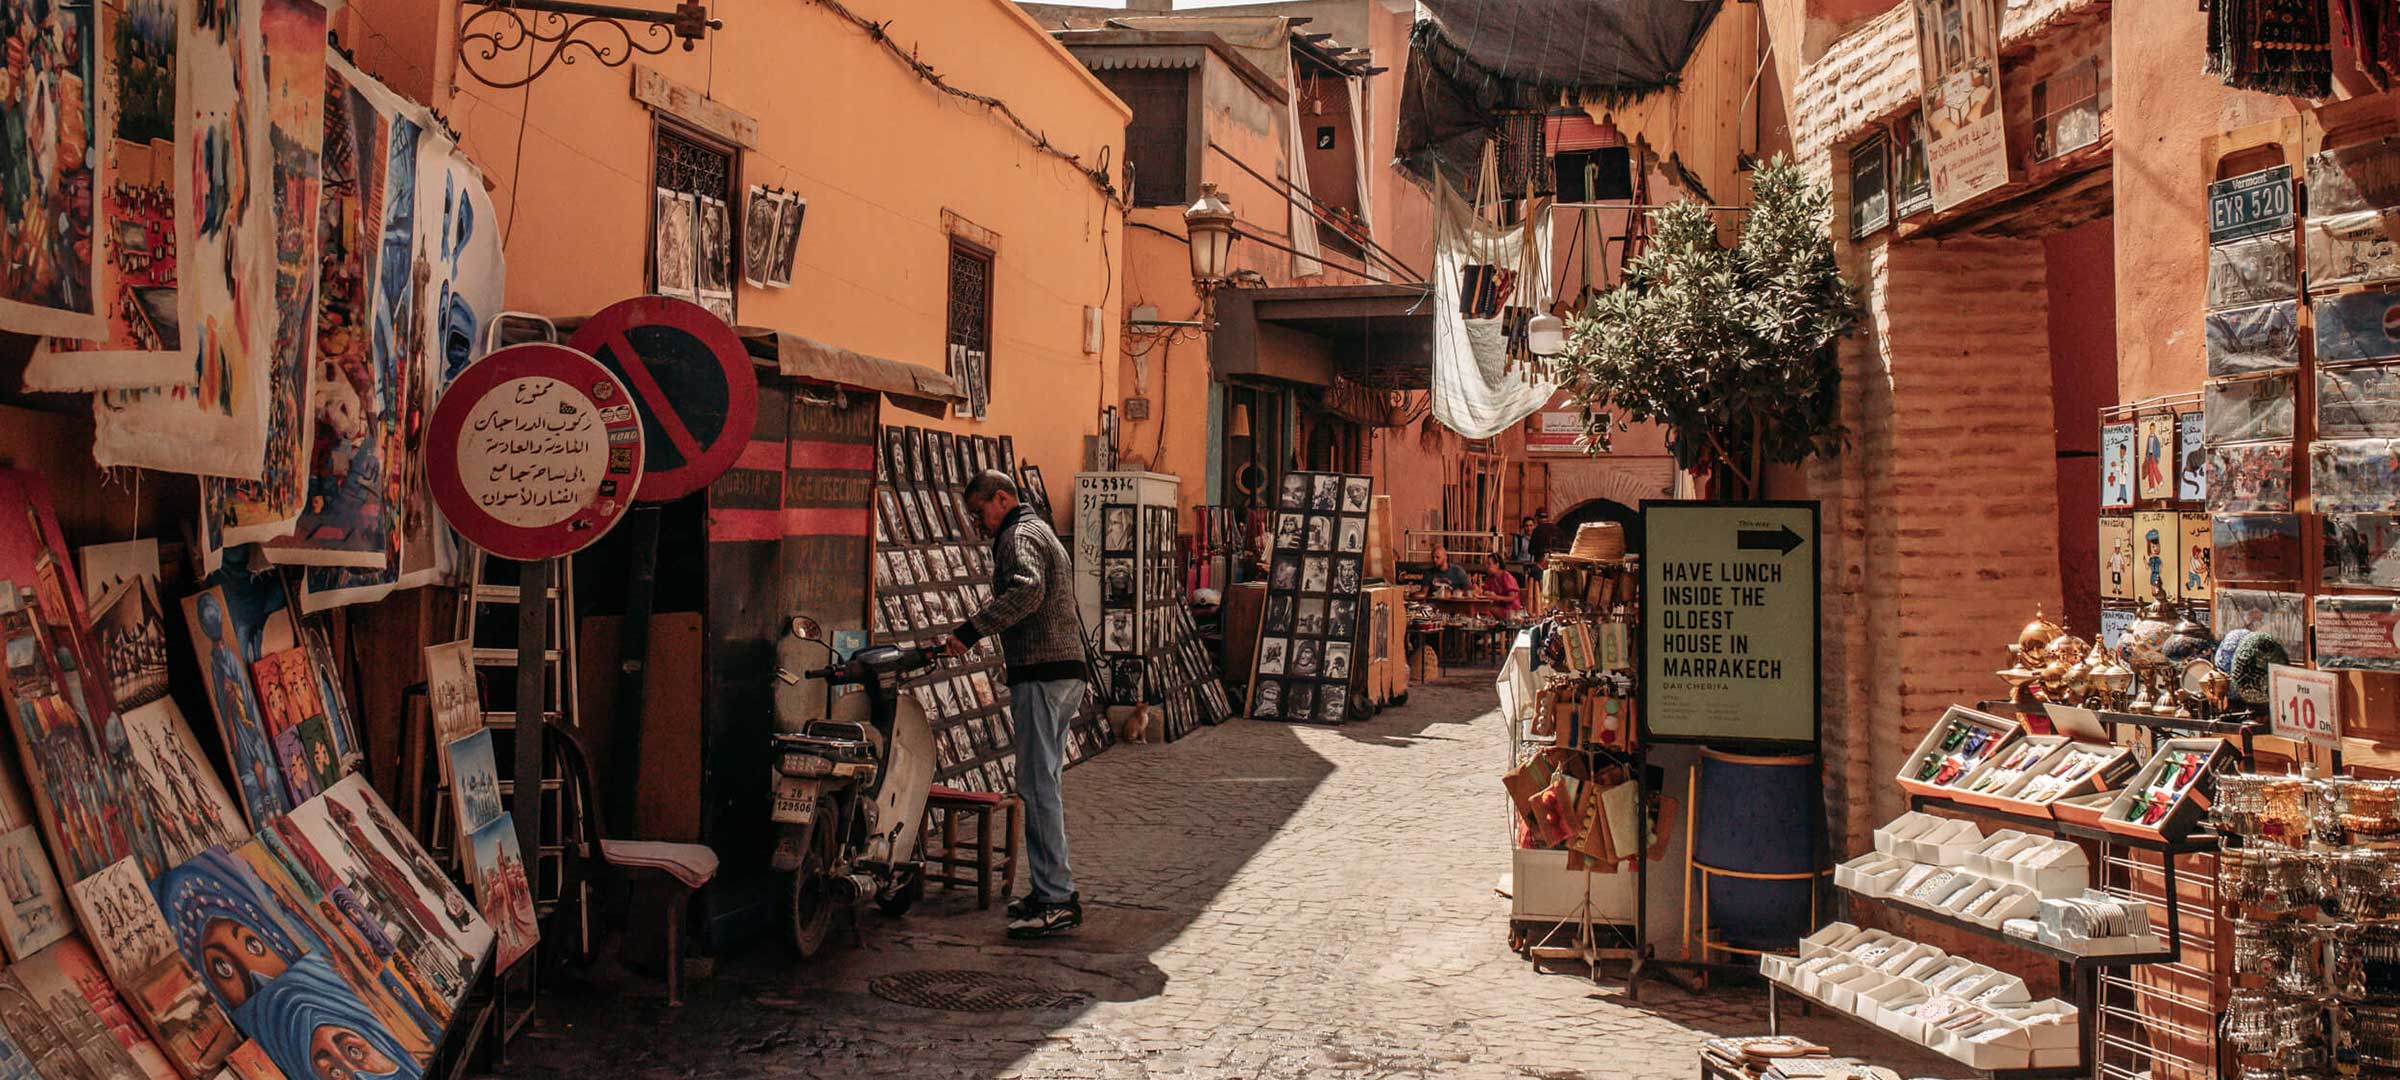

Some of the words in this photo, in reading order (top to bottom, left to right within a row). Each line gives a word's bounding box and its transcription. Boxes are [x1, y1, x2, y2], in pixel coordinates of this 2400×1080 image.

[2232, 173, 2268, 190] Vermont
[2215, 194, 2244, 228] EYR
[2251, 185, 2285, 220] 520
[515, 382, 554, 404] ممنوع
[474, 410, 546, 432] الدراجات
[547, 412, 592, 436] ركوب
[610, 430, 637, 442] KOKO
[486, 438, 542, 454] والعادية
[544, 438, 589, 454] النارية
[490, 463, 530, 482] جامع
[532, 464, 566, 482] ساحة
[565, 466, 586, 482] إلى
[481, 487, 547, 506] والأسواق
[549, 488, 578, 505] الفنا
[1663, 562, 1713, 582] HAVE
[1721, 563, 1782, 583] LUNCH
[1663, 586, 1722, 606] INSIDE
[1731, 587, 1765, 606] THE
[1663, 610, 1734, 630] OLDEST
[1663, 634, 1722, 654] HOUSE
[1730, 635, 1748, 654] IN
[1663, 658, 1782, 679] MARRAKECH
[1662, 682, 1683, 690] DAR
[1686, 682, 1729, 691] CHERIFA
[2289, 695, 2316, 730] 10
[2320, 720, 2332, 732] Dh
[777, 801, 811, 813] 129506
